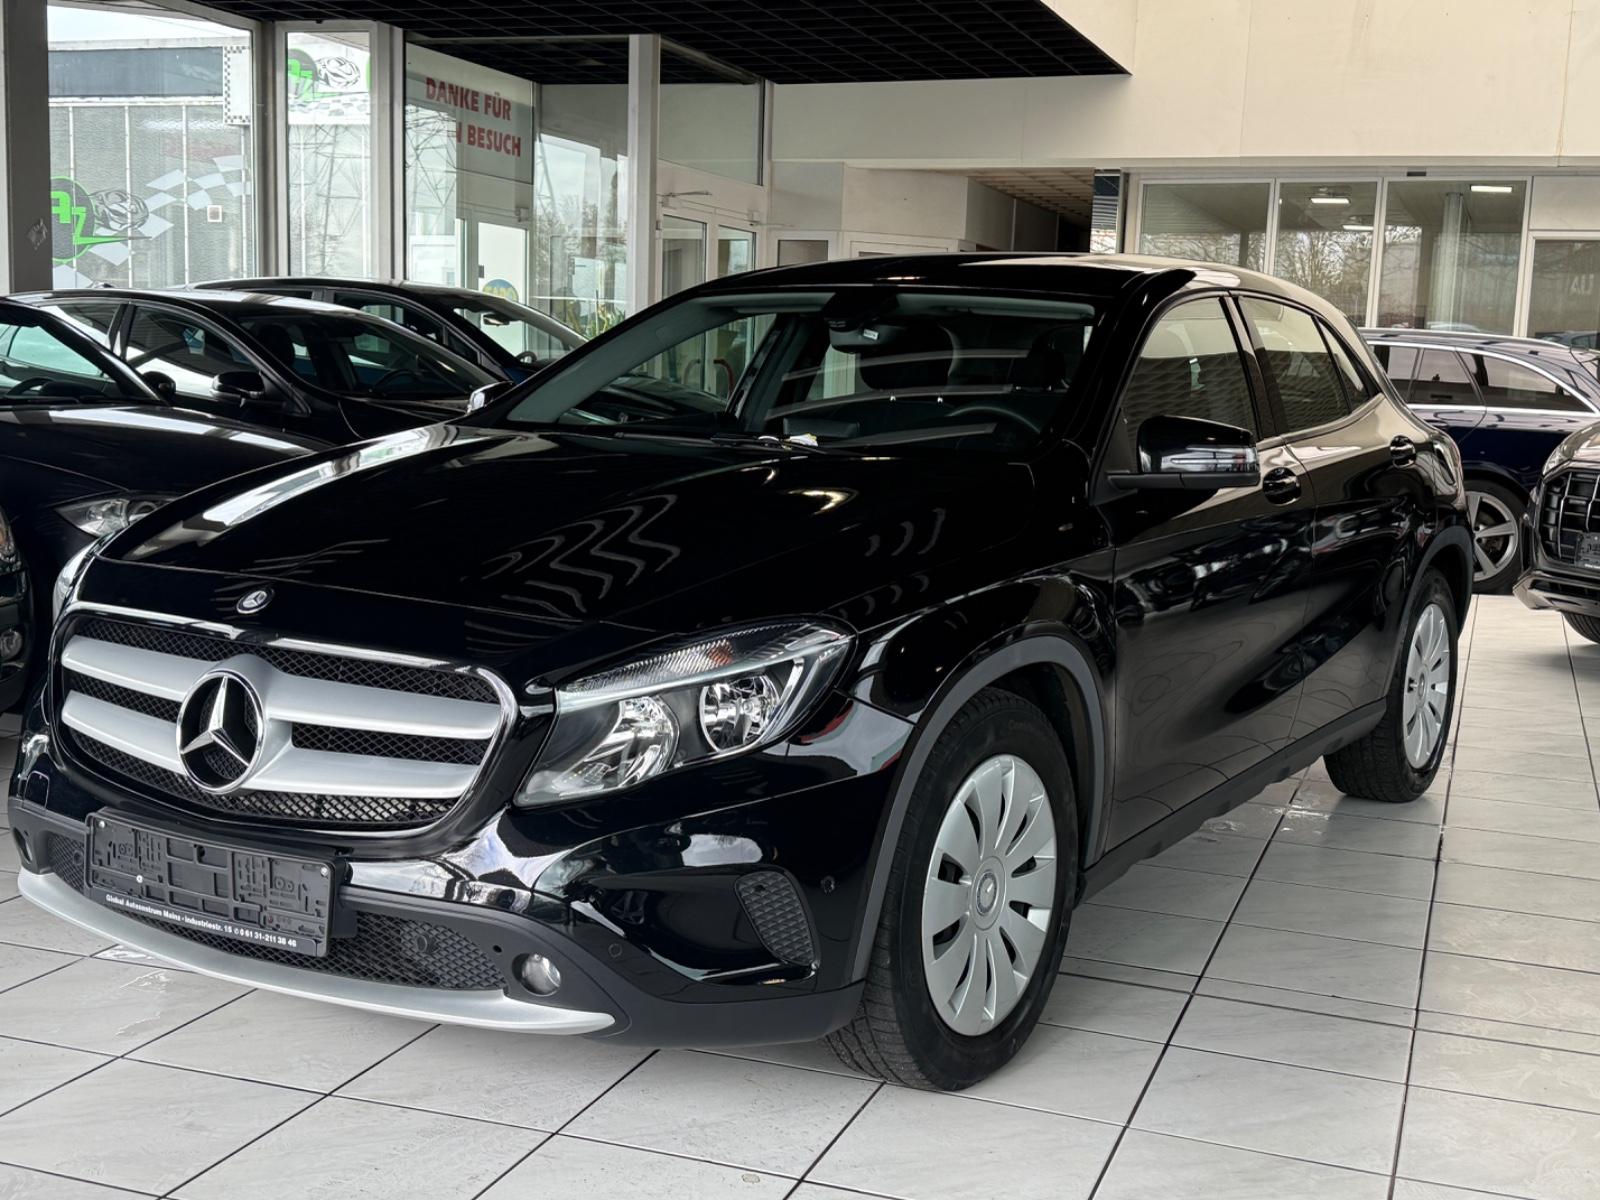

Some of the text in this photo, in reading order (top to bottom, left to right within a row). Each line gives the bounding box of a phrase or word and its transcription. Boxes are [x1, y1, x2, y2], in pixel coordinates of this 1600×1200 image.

[426, 77, 511, 121] DANKE FÜR
[468, 124, 521, 157] BESUCH
[105, 893, 125, 906] Global
[125, 899, 163, 916] Autozentrum
[163, 909, 181, 922] Mainz
